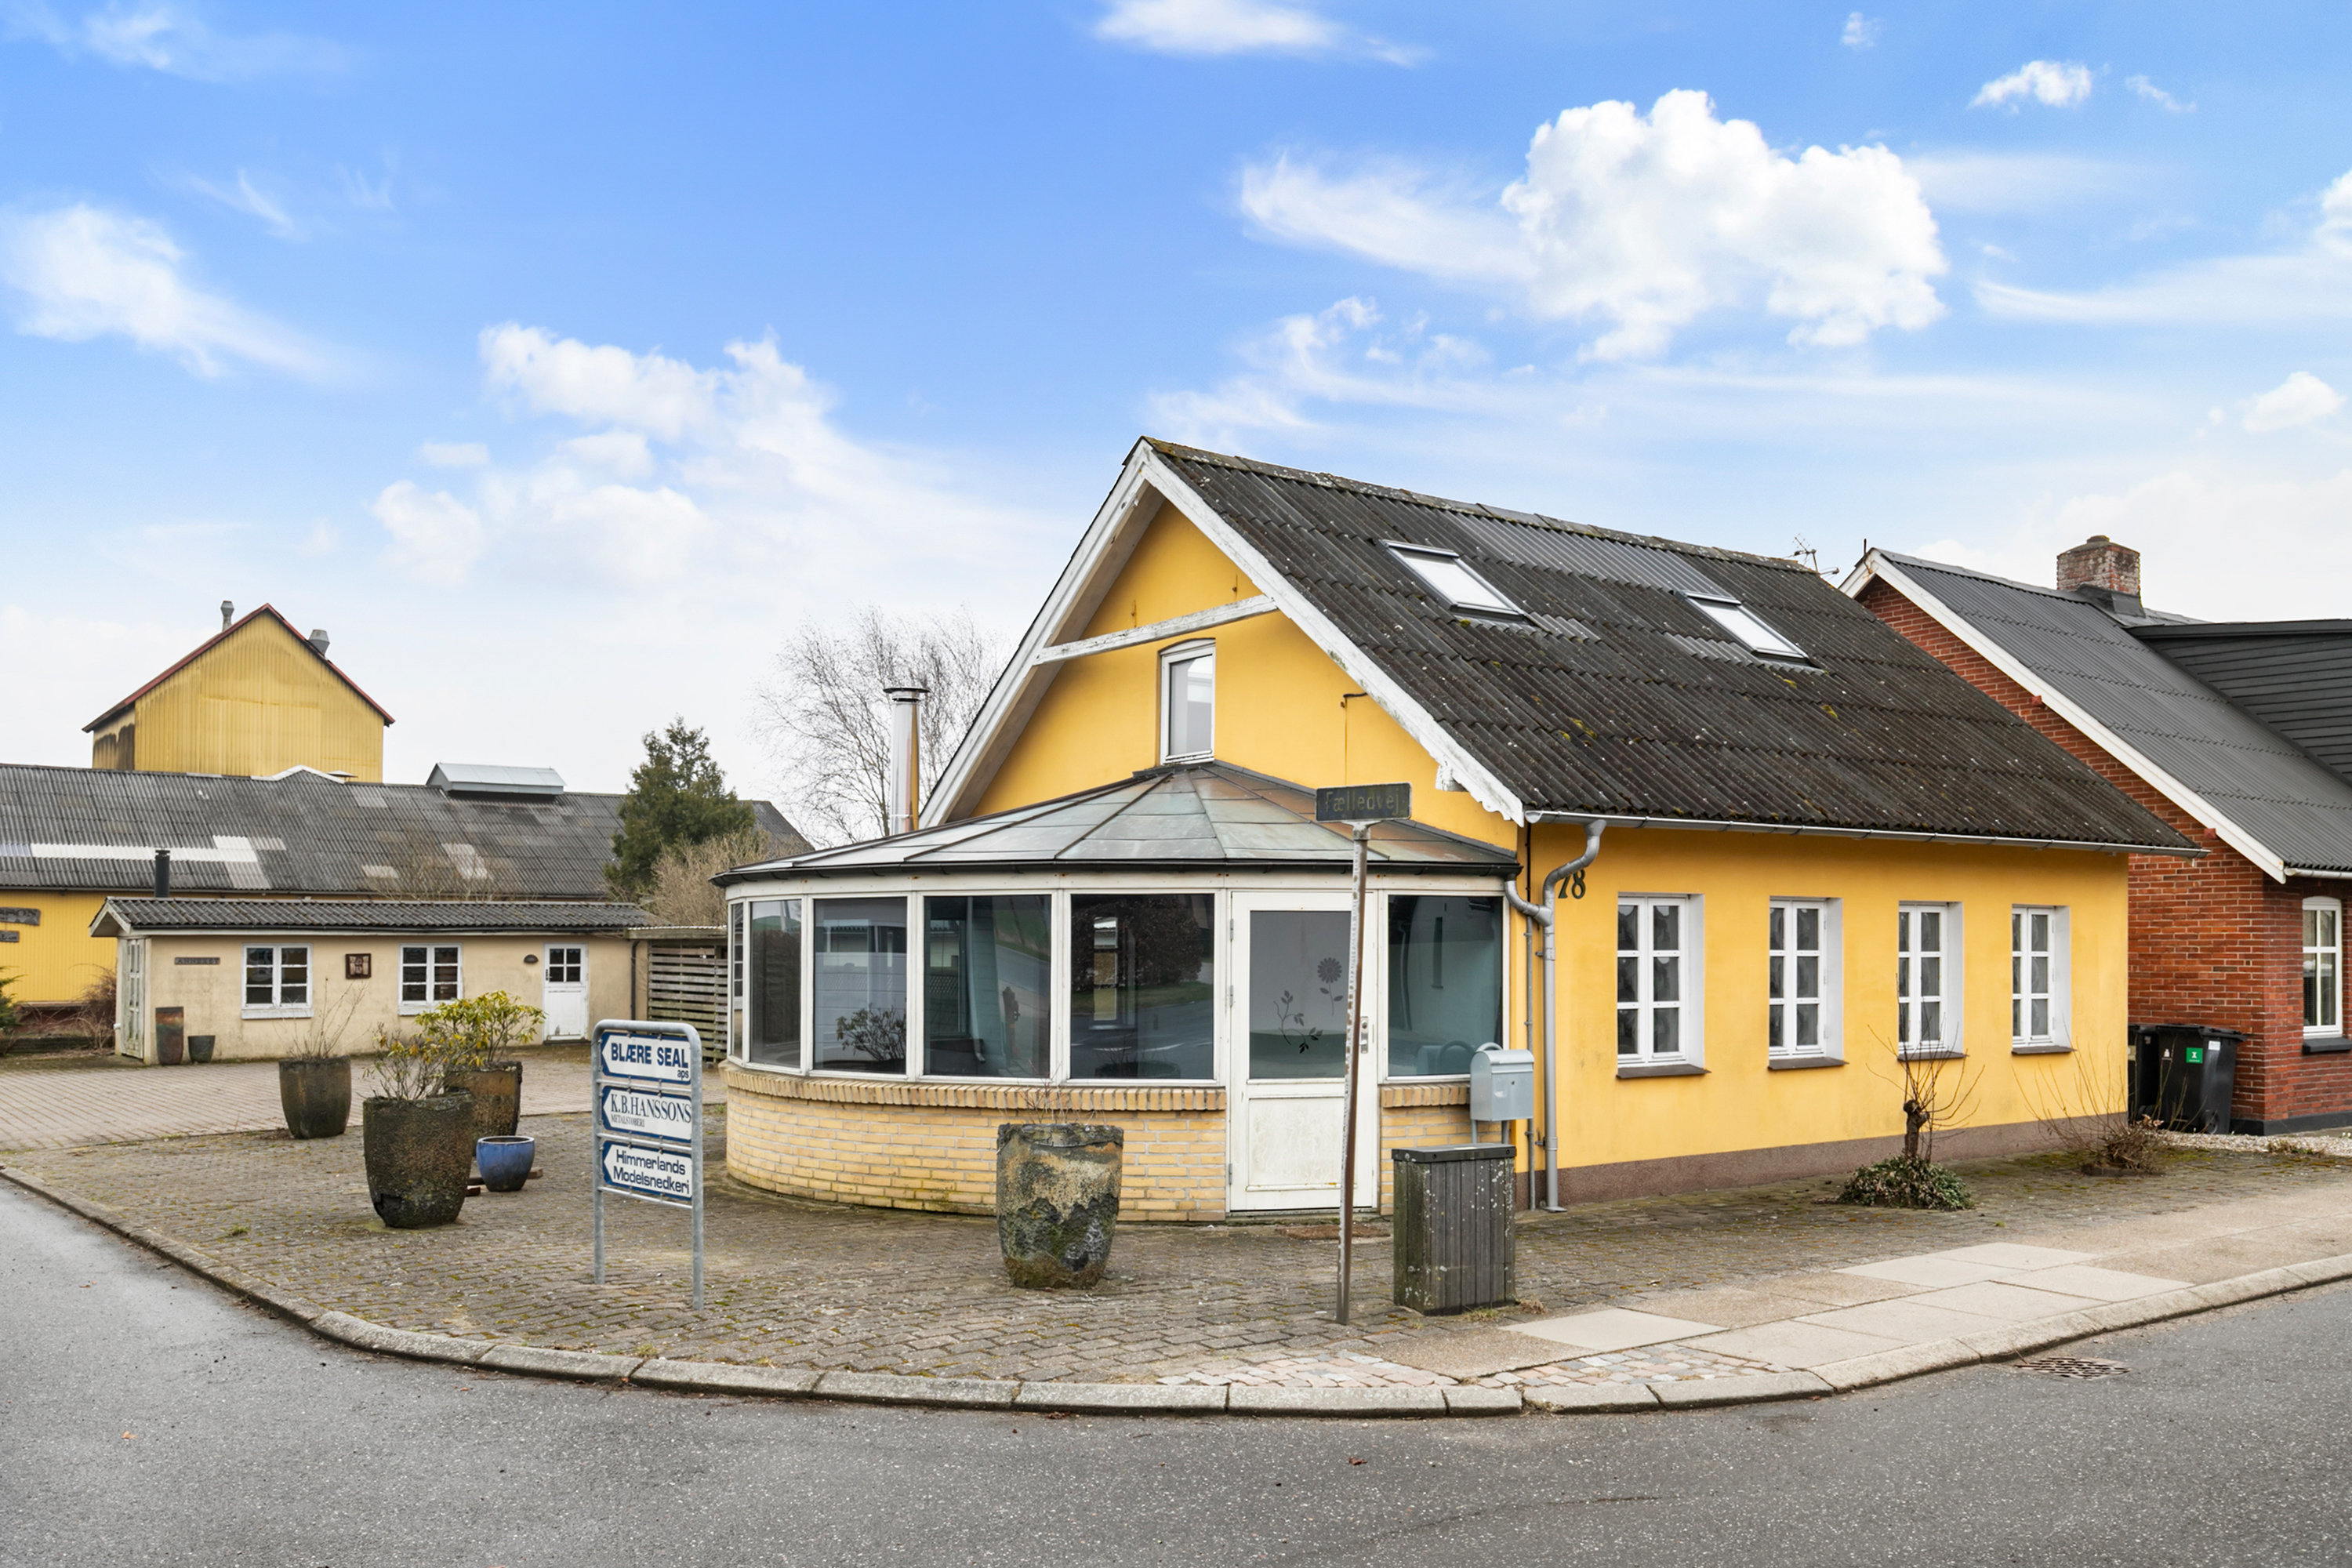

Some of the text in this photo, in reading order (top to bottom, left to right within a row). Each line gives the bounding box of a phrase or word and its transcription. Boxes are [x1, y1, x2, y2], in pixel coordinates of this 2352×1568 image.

[1325, 788, 1399, 815] Fælledvej
[611, 1043, 688, 1069] BLÆRE SEAL
[677, 1069, 689, 1081] aps
[616, 1149, 686, 1175] Himmerlands
[613, 1166, 689, 1194] Modelsnedkeri
